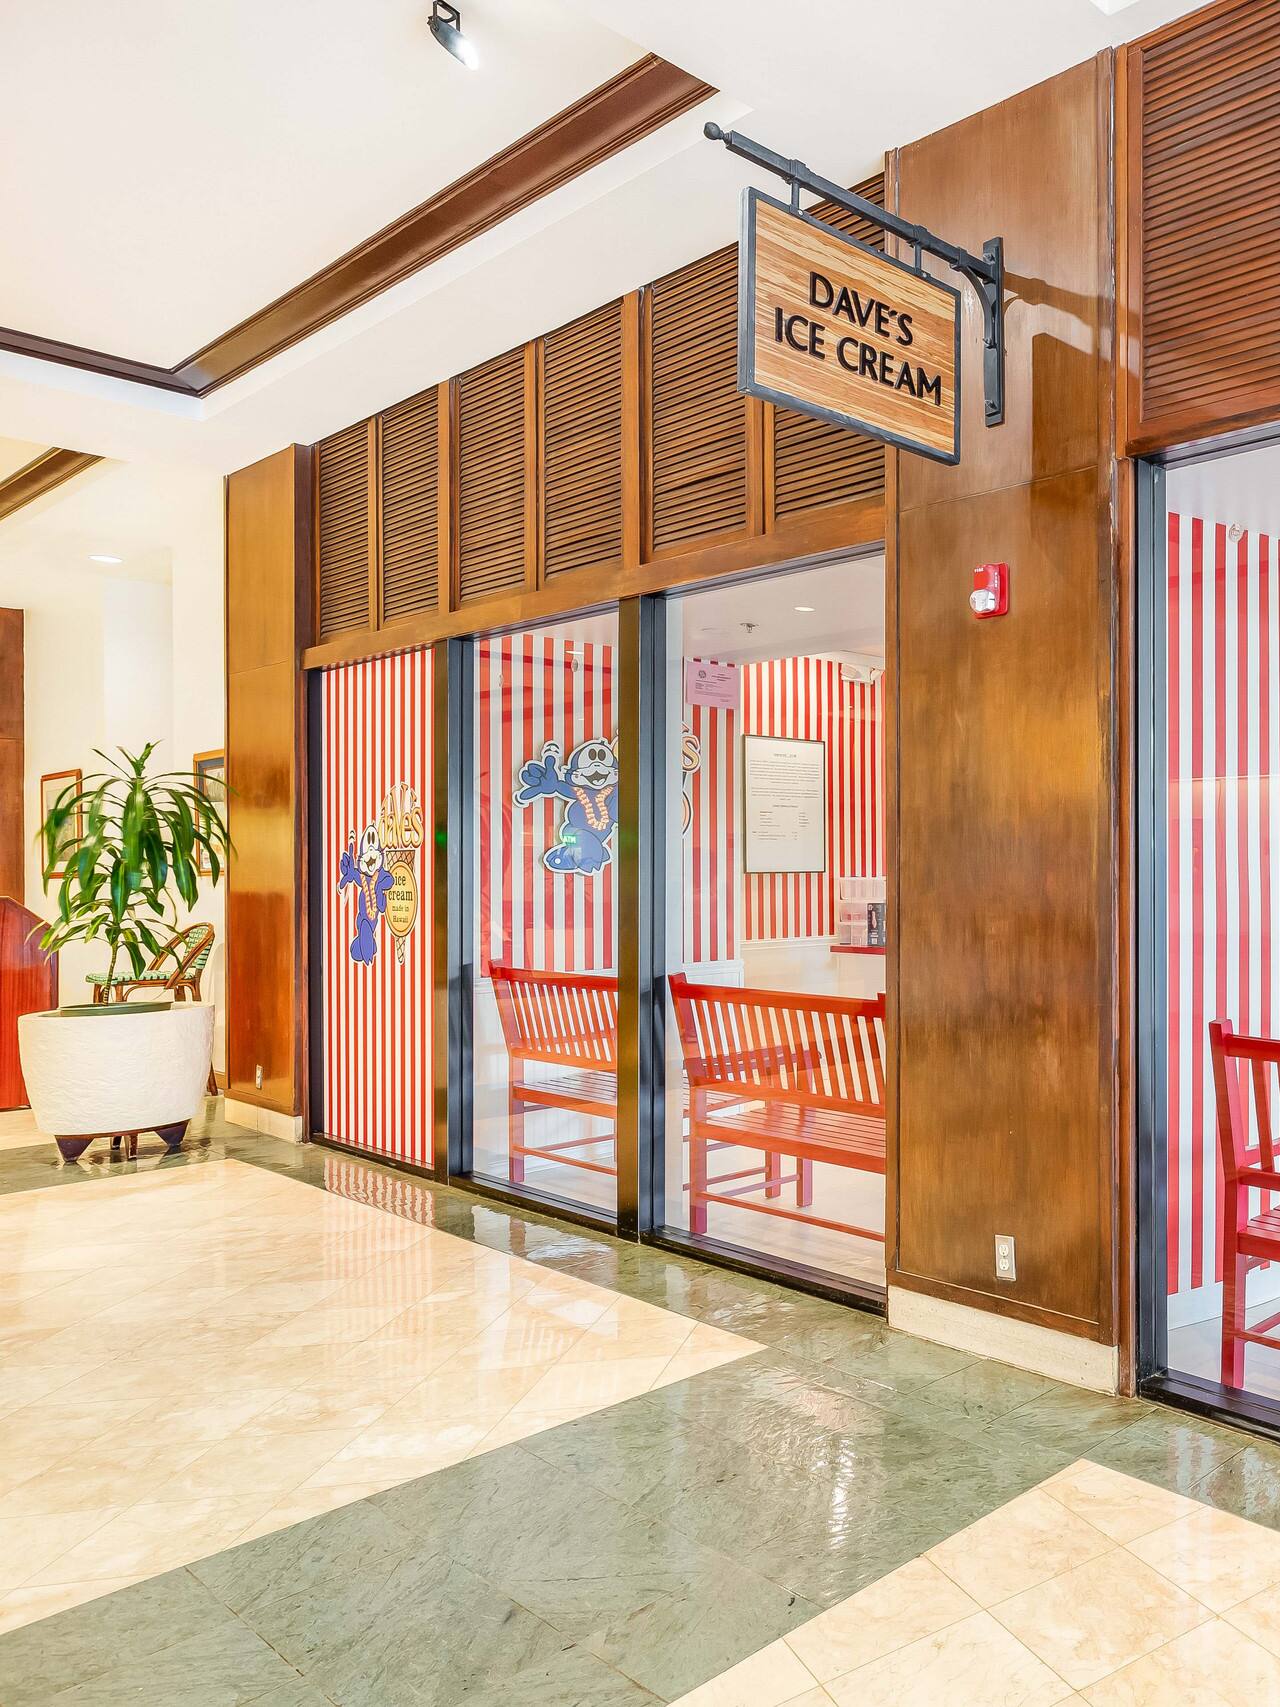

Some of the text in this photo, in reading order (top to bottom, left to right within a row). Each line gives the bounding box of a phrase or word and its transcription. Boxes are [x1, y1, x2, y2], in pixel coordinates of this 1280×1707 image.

[810, 271, 912, 346] DAVE'S
[775, 306, 942, 406] ICE CREAM
[378, 783, 424, 849] dave's
[388, 890, 413, 901] cream
[394, 872, 406, 886] ice
